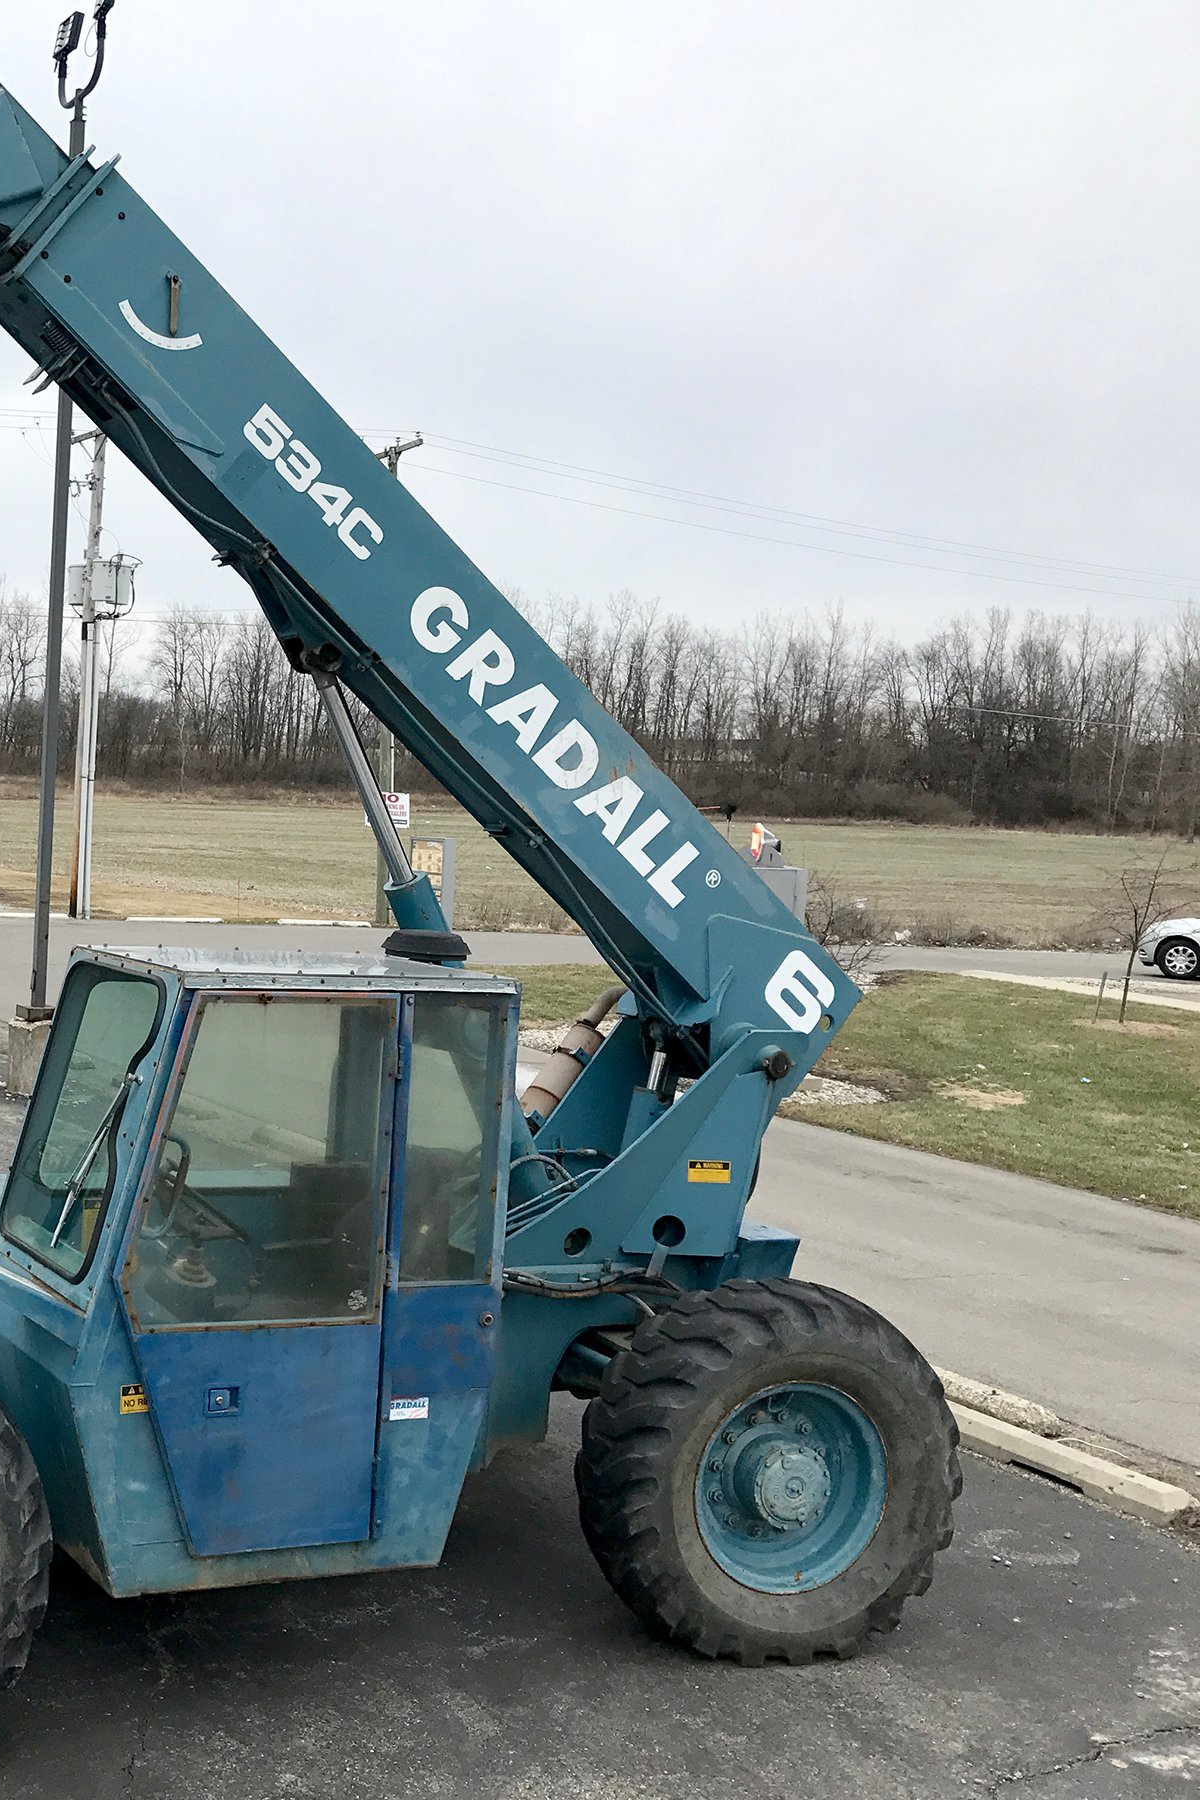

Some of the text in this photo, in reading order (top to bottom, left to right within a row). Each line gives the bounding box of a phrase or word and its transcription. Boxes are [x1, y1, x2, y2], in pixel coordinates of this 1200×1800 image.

[243, 403, 384, 561] 534C
[410, 586, 701, 909] GRADALL
[764, 950, 835, 1034] 6
[123, 1399, 135, 1407] NO
[390, 1401, 427, 1409] GRADALL
